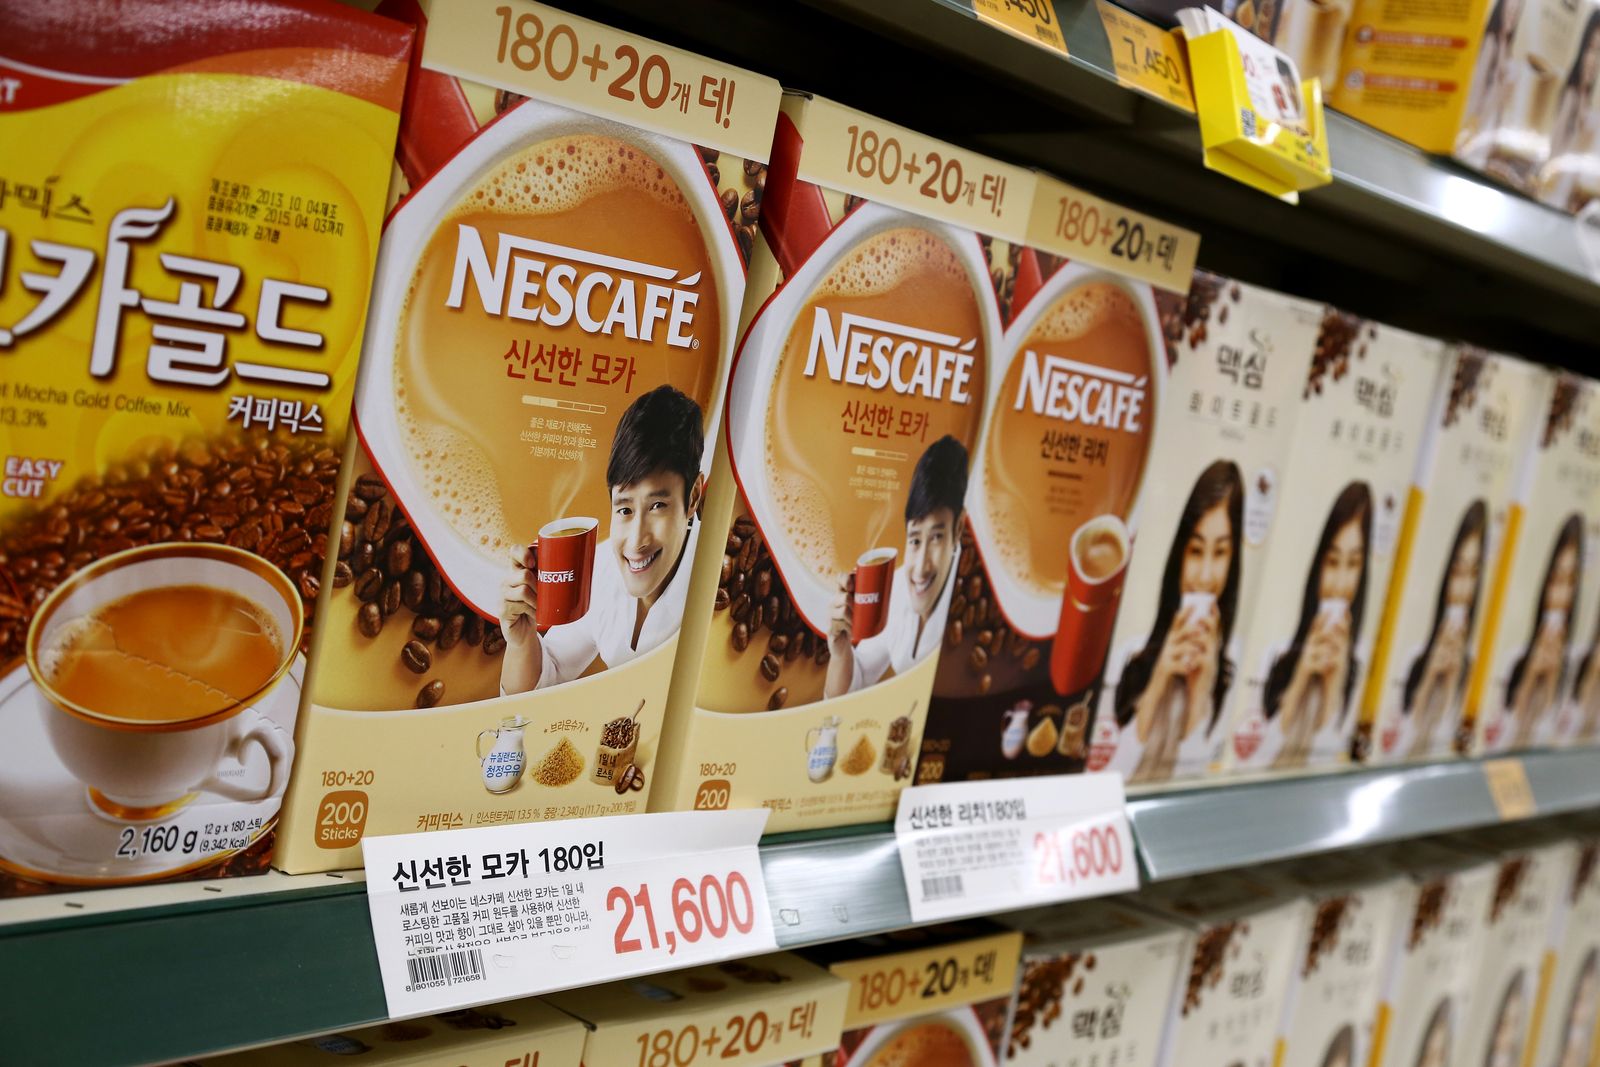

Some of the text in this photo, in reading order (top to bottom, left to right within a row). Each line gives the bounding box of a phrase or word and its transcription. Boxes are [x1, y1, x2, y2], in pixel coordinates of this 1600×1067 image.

[495, 6, 691, 114] 180+20개
[1123, 36, 1181, 84] 7,450
[846, 124, 976, 206] 180+20개
[445, 223, 701, 349] NESCAFÉ
[503, 339, 637, 394] 신선한 모카
[803, 306, 978, 405] NESCAFÉ
[14, 383, 68, 405] Mocha
[73, 389, 110, 410] Gold
[115, 395, 161, 415] Coffee
[166, 401, 192, 418] Mix
[1014, 350, 1148, 433] NESCAFÉ
[226, 395, 325, 433] 커피믹스
[841, 400, 929, 443] 신선한 모카
[1040, 430, 1082, 463] 신선한
[5, 457, 63, 479] EASY
[3, 478, 44, 498] CUT
[486, 764, 522, 779] 청정우유
[490, 751, 524, 764] 뉴질랜드산
[595, 767, 614, 781] 로스팅
[699, 762, 737, 776] 180+20
[321, 769, 375, 787] 180+20
[321, 802, 366, 826] 200
[697, 788, 729, 809] 200
[321, 826, 359, 841] Sticks
[416, 812, 464, 832] 커피믹스
[909, 803, 953, 830] 신선한
[118, 825, 180, 858] 2,160
[182, 829, 199, 855] g
[231, 821, 246, 832] 180
[246, 817, 263, 831] 스틱
[1033, 822, 1123, 887] 21,600
[392, 840, 605, 893] 신선한 모카 180입
[400, 881, 585, 916] 새롭게 선보이는 네스카페 신선한 모카는 1일 내
[402, 897, 581, 932] 로스팅한 고품질 커피 원두를 사용하여 신선한
[605, 870, 755, 956] 21,600
[405, 933, 433, 947] 커피의
[435, 930, 455, 944] 맛과
[457, 927, 476, 941] 향이
[478, 922, 505, 937] 그대로
[507, 919, 525, 934] 살아
[527, 916, 544, 931] 있을
[564, 910, 592, 925] 아니라,
[416, 980, 446, 991] 801055
[453, 973, 481, 985] 721658
[857, 957, 970, 1013] 180+20개
[637, 1010, 784, 1067] 180+20개
